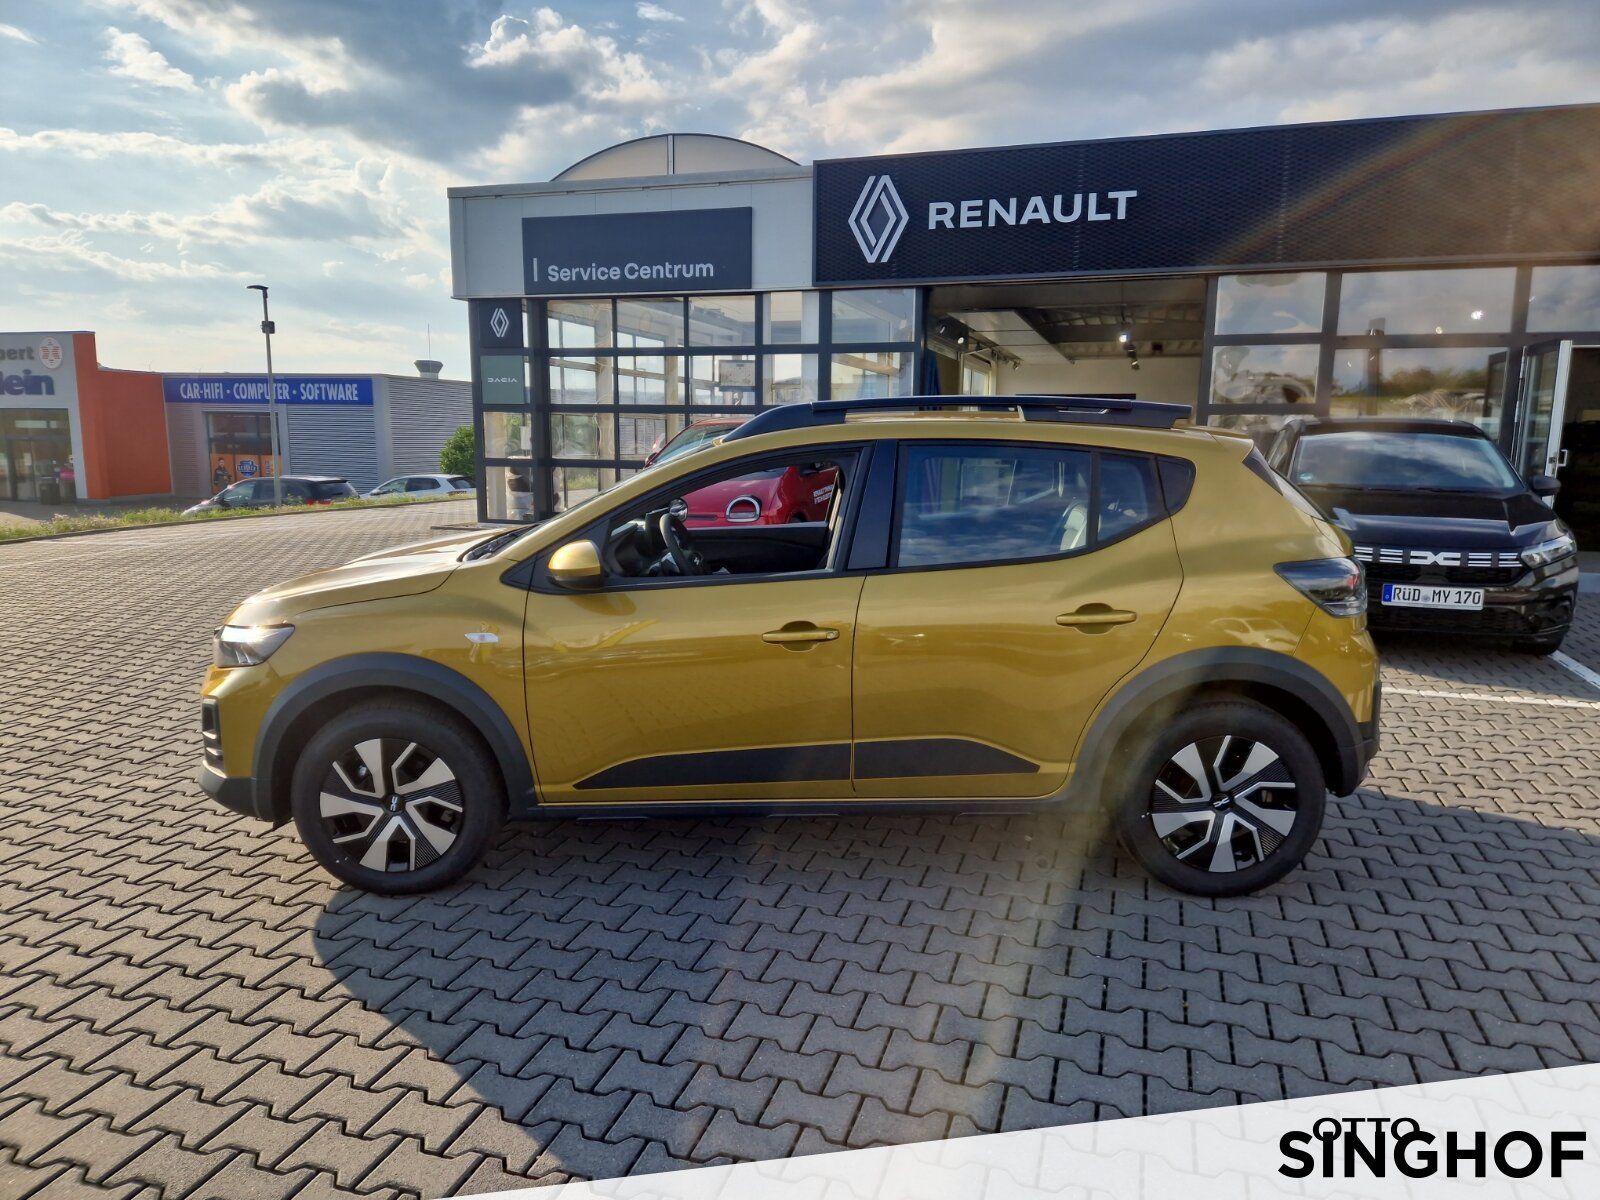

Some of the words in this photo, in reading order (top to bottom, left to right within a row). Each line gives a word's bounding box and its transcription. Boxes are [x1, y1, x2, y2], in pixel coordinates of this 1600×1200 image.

[928, 190, 1138, 230] RENAULT
[547, 263, 620, 282] Service
[624, 262, 714, 279] Centrum
[180, 383, 223, 399] CAR-HIFI
[233, 383, 290, 400] COMPUTER
[300, 383, 359, 401] SOFTWARE
[1431, 589, 1451, 604] MY
[1454, 590, 1481, 605] 170
